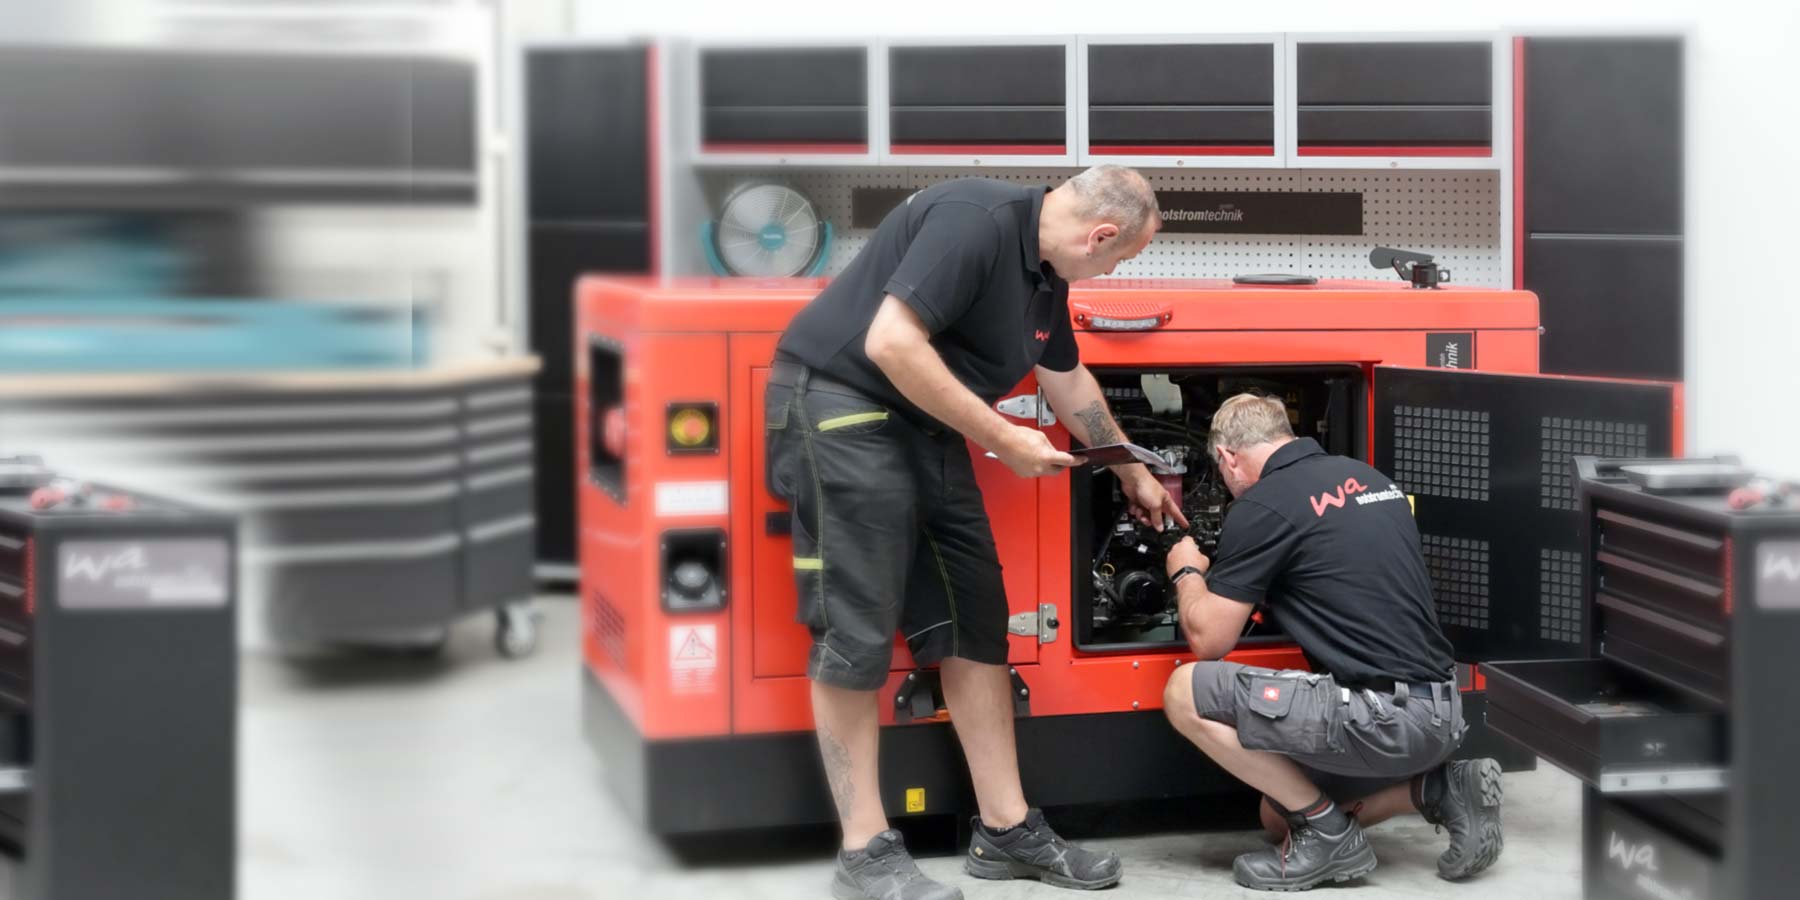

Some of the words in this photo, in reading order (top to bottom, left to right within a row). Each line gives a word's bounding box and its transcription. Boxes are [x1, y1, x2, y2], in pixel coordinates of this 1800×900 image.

[1160, 209, 1244, 221] otstromtechnik
[1309, 477, 1368, 517] wa
[1608, 830, 1658, 870] wa
